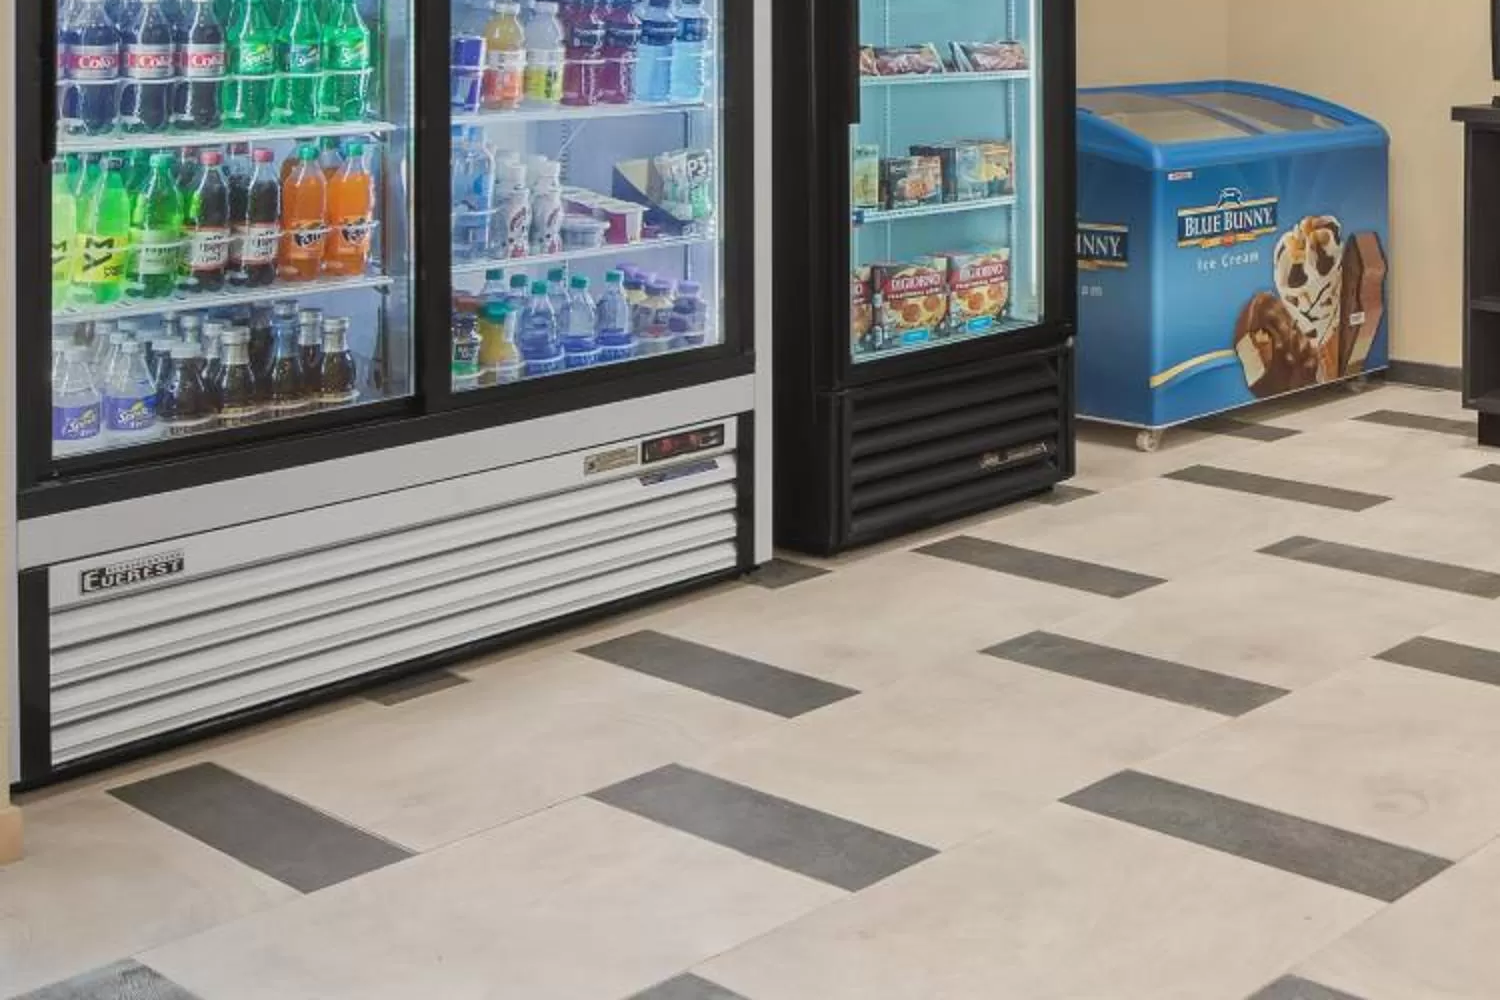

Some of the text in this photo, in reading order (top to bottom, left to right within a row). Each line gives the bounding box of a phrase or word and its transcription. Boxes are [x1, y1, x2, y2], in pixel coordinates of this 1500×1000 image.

[1185, 207, 1273, 237] BLUE BUNNY
[1077, 234, 1122, 257] NNY
[1197, 251, 1260, 272] Ice Cream
